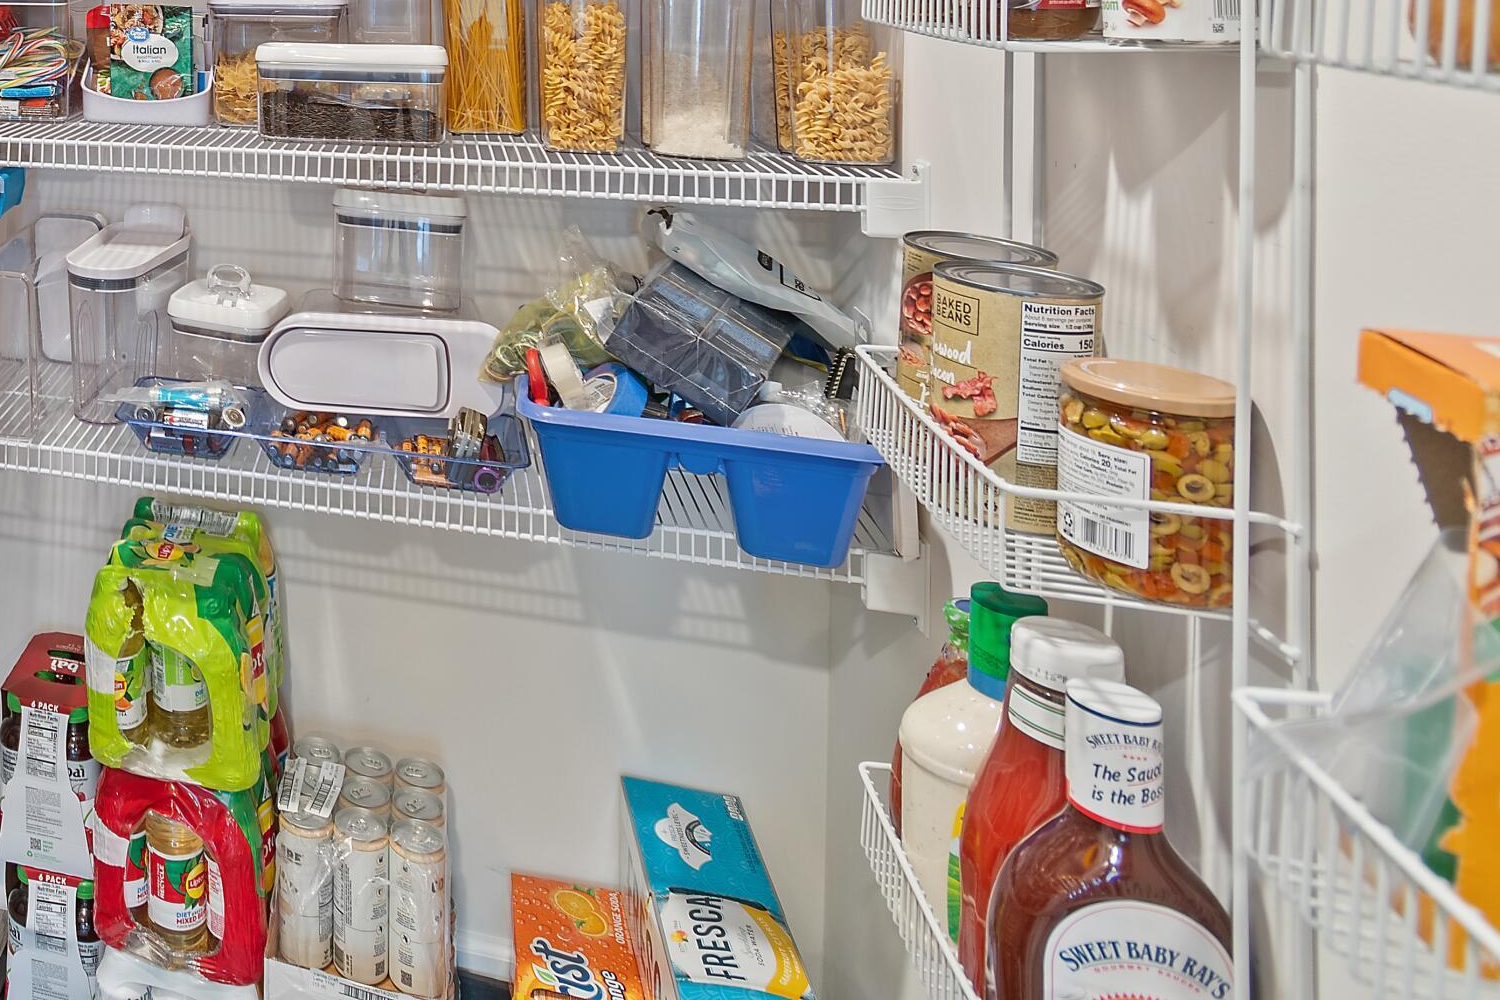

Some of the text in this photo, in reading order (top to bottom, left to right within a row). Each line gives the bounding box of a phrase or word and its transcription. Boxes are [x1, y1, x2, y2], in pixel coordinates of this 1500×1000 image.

[132, 45, 167, 55] Italian
[936, 293, 972, 315] BAKED
[1024, 304, 1095, 316] Nutrition Facts
[936, 304, 972, 327] BEANS
[1024, 339, 1093, 350] Calories 150
[38, 702, 59, 713] PACK
[50, 730, 57, 740] 10
[1085, 734, 1150, 749] SWEET BABY
[1092, 763, 1121, 783] The
[1092, 785, 1135, 805] is the
[671, 812, 691, 857] SWEETNESS LEVEL
[45, 875, 67, 885] PACK
[59, 906, 66, 914] 10
[609, 892, 626, 945] ORANGE SODA
[176, 916, 197, 925] MIXED
[685, 895, 747, 981] FRESCA
[745, 924, 766, 967] SODA WATER
[1059, 941, 1231, 1000] SWEET BABY RAY'S
